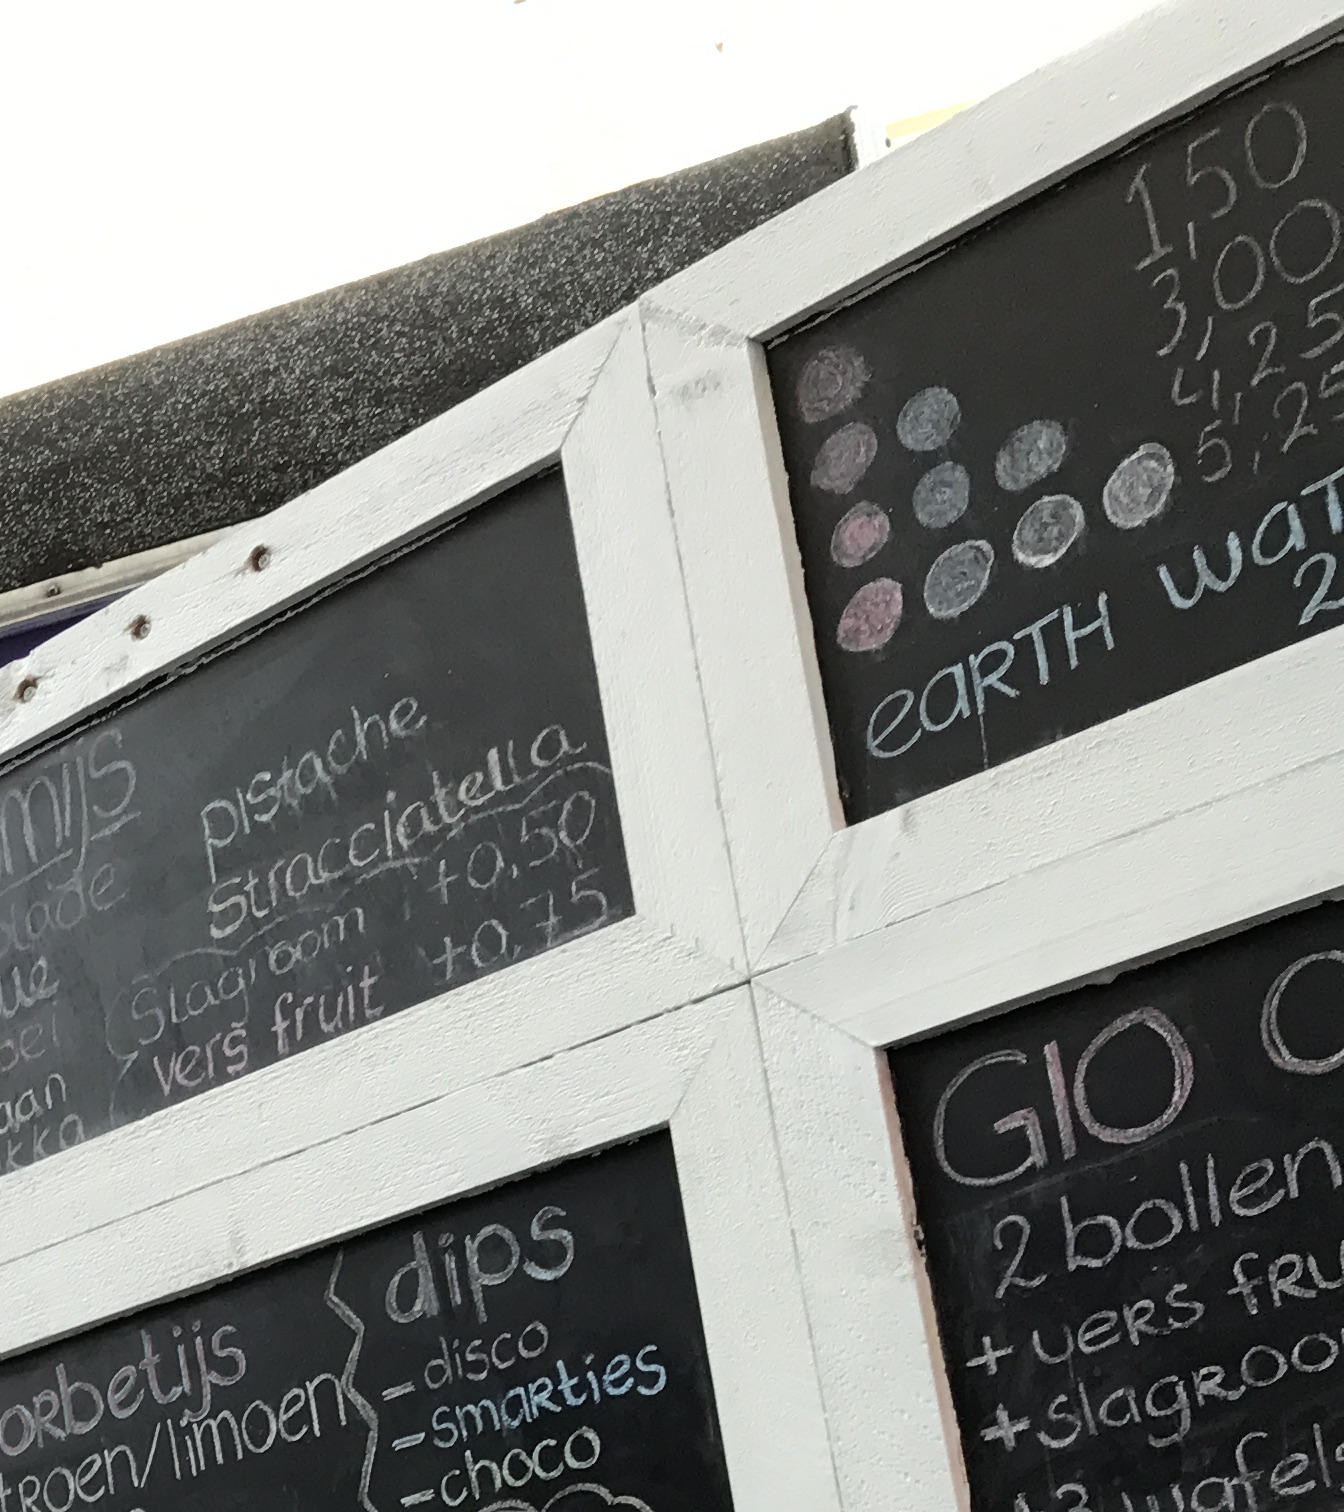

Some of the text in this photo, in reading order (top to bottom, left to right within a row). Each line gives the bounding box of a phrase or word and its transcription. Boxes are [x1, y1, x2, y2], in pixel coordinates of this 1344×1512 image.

[270, 965, 384, 1055] fruit
[385, 1206, 576, 1324] dips
[993, 1137, 1343, 1298] 2 bollen
